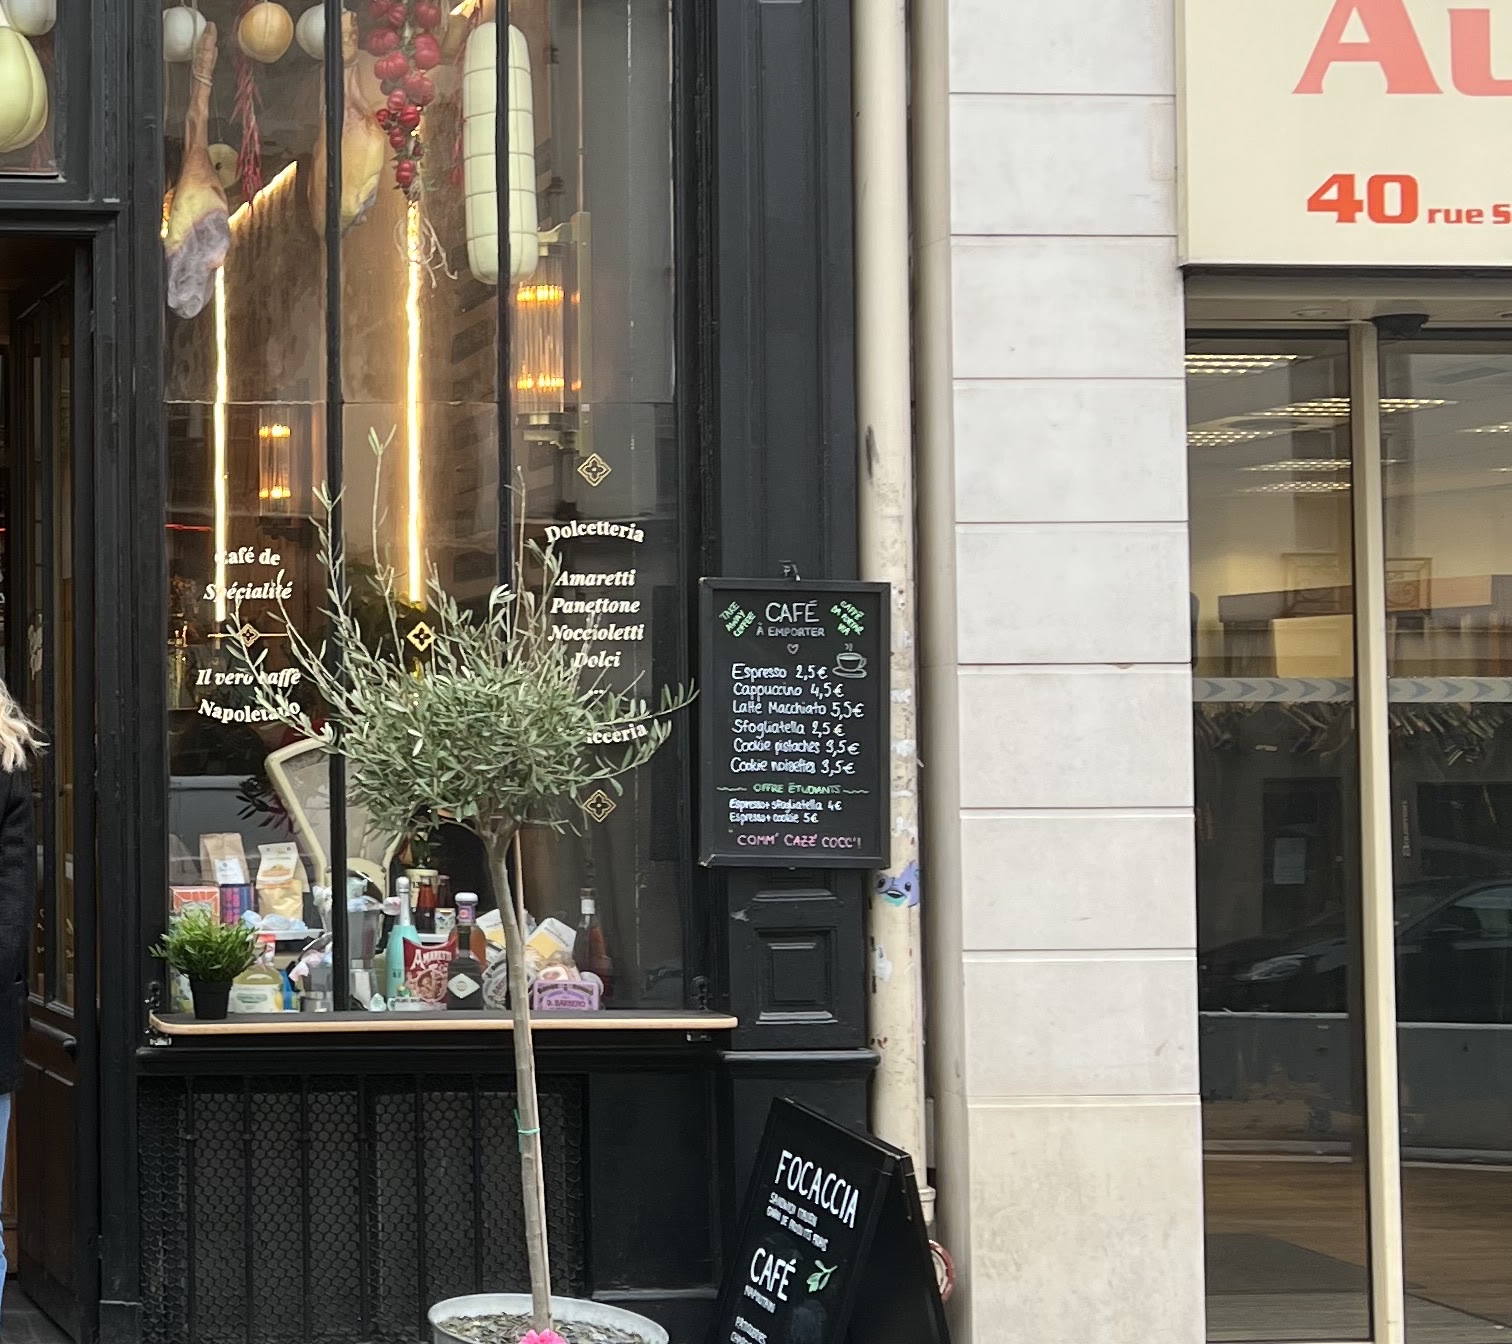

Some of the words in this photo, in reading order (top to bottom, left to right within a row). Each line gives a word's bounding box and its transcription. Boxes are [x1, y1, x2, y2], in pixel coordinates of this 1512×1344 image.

[1306, 173, 1419, 224] 40
[1428, 208, 1484, 224] rue
[544, 520, 645, 543] Dolcetteria
[258, 548, 281, 566] de
[555, 569, 637, 587] Amaretti
[549, 597, 641, 614] Panettone
[765, 600, 820, 623] CAFÉ
[547, 623, 645, 641] Noccioletti
[767, 626, 825, 637] EMPORTER
[573, 650, 622, 669] Dolci
[195, 668, 213, 686] Il
[214, 672, 254, 686] vero
[731, 663, 788, 683] Espresso
[732, 681, 803, 702] Cappuccino
[732, 699, 763, 715] Latte
[768, 701, 827, 716] Macchiato
[731, 718, 806, 740] Sfogliatella
[733, 737, 772, 753] Cookie
[730, 756, 768, 773] Cookie
[752, 782, 785, 794] OFFRE
[787, 782, 842, 795] ÉTUDIANTS
[774, 1149, 859, 1229] FOCACCIA
[750, 1247, 797, 1302] CAFÉ
